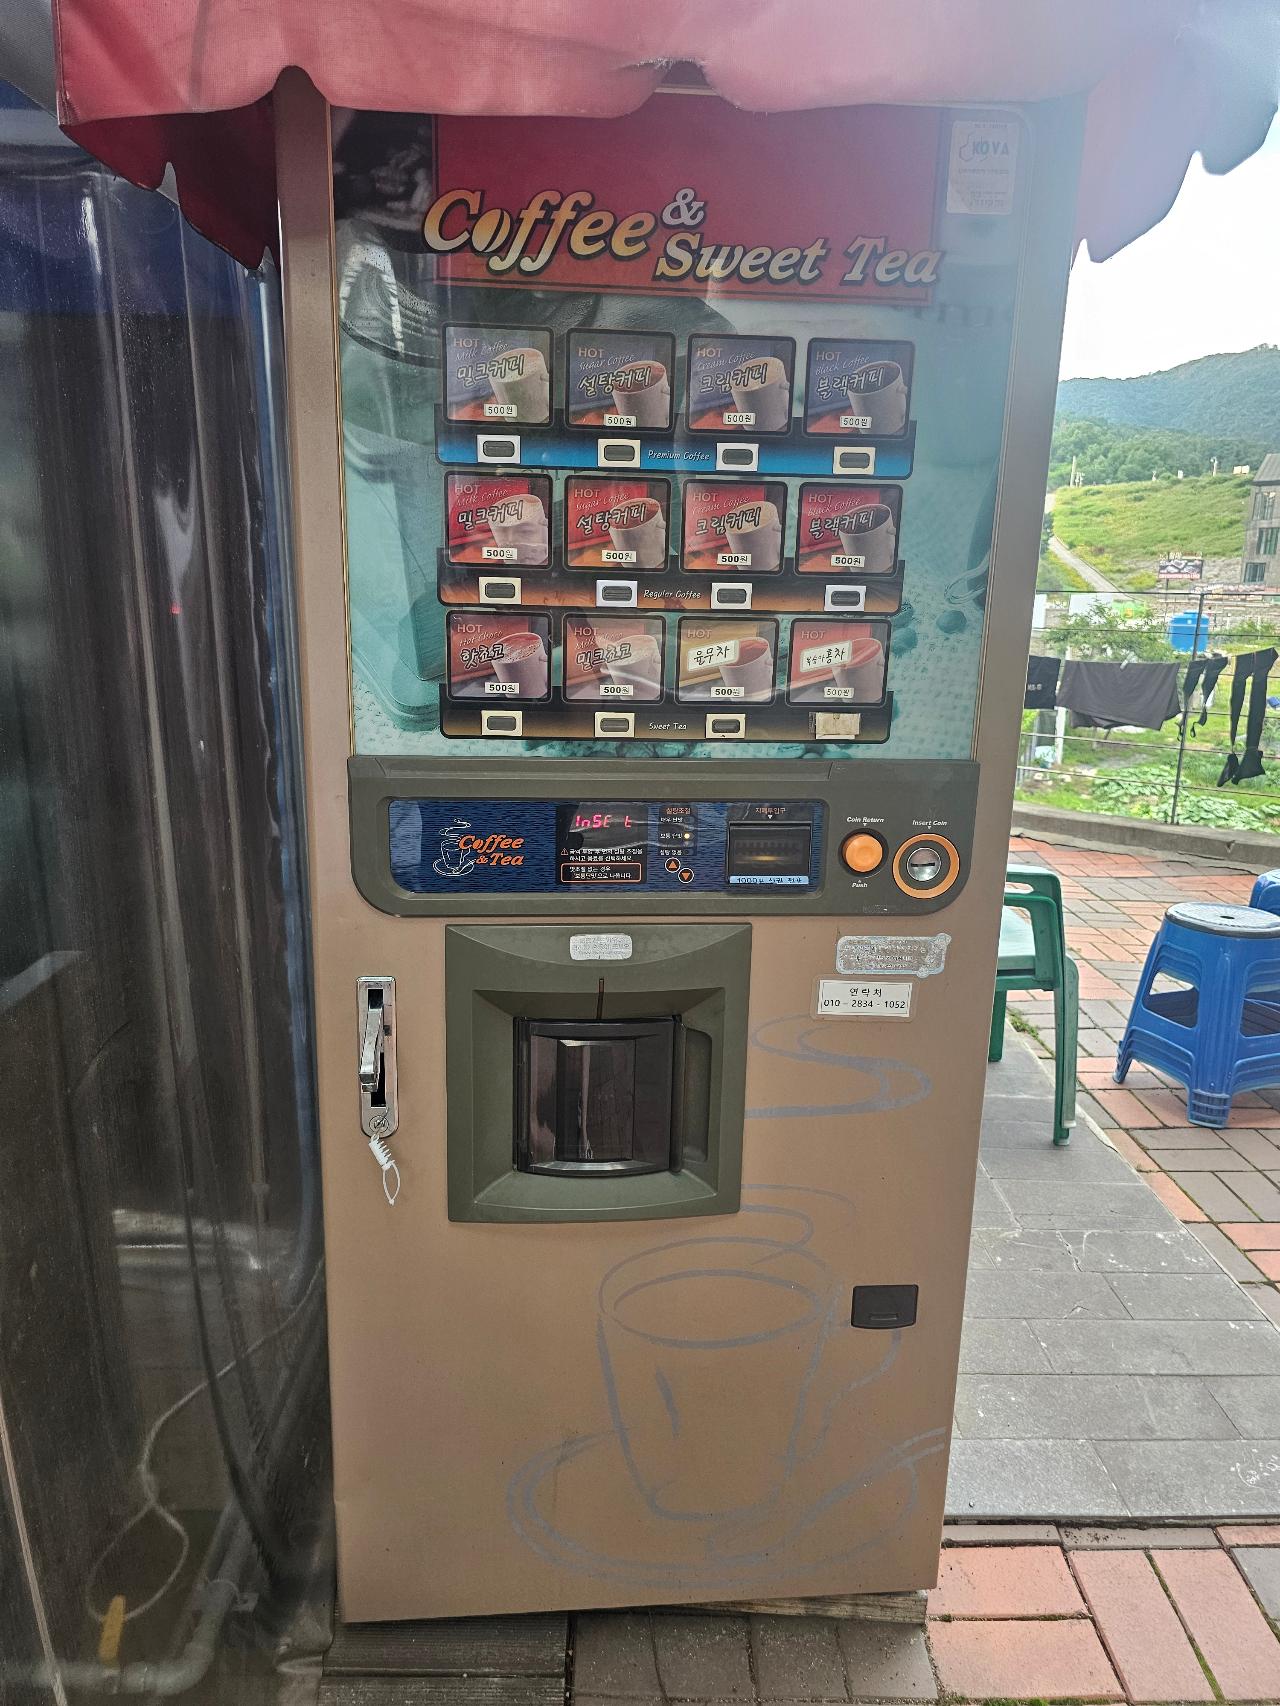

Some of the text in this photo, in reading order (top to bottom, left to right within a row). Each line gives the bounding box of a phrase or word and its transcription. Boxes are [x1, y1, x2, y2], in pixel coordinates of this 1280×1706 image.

[422, 187, 705, 274] Coffee &
[654, 232, 942, 285] Sweet Tea
[454, 338, 480, 348] HOT
[578, 348, 605, 358] HOT
[697, 348, 723, 358] HOT
[816, 351, 842, 361] HOT
[457, 354, 525, 387] 밀크커피
[578, 366, 651, 397] 설탕커피
[700, 363, 768, 393] 크림커피
[817, 367, 884, 400] 블랙커피
[488, 405, 513, 415] 500원
[647, 449, 710, 461] Premium Coffee
[454, 484, 480, 494] HOT
[574, 488, 600, 498] HOT
[693, 492, 719, 502] HOT
[808, 494, 834, 504] HOT
[457, 500, 524, 531] 밀크커피
[576, 503, 646, 535] 설탕커피
[695, 507, 762, 536] 크림커피
[809, 510, 875, 540] 블랙커피
[643, 589, 701, 600] Regular Coffee
[457, 624, 483, 633] HOT
[574, 627, 599, 636] HOT
[687, 629, 712, 639] HOT
[801, 630, 826, 640] HOT
[649, 722, 687, 730] Sweet Tea
[458, 834, 525, 854] Coffee
[489, 853, 524, 866] Tea
